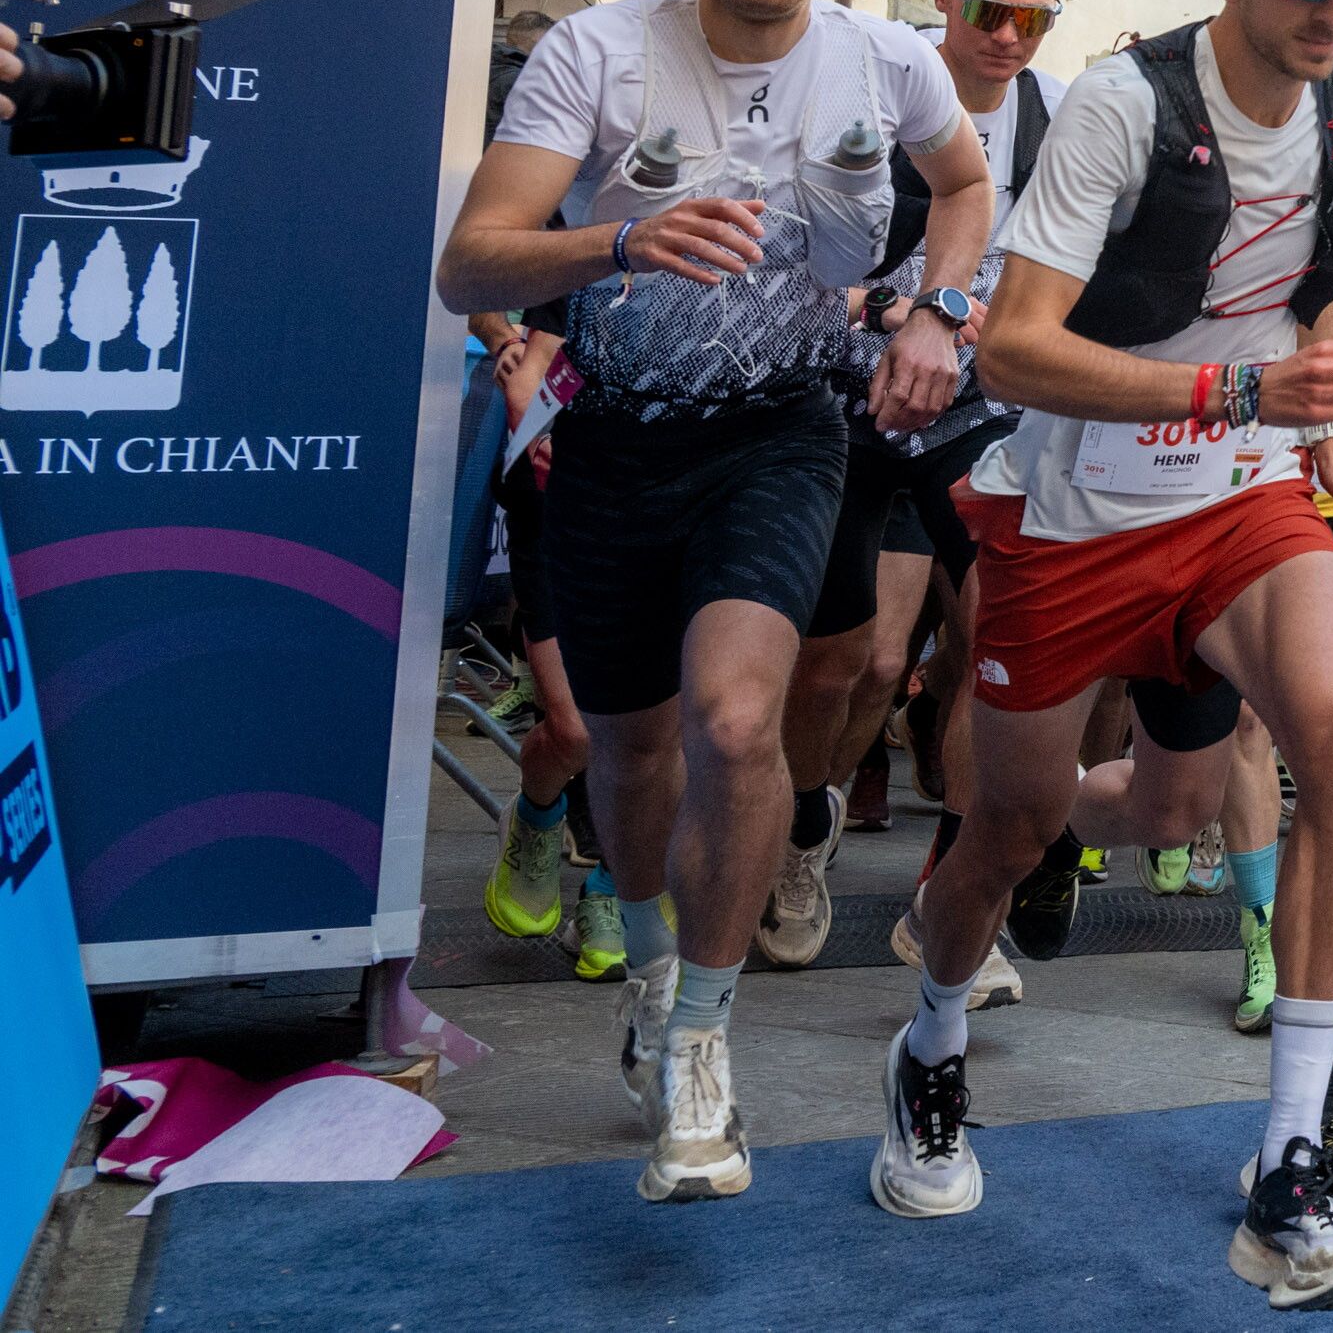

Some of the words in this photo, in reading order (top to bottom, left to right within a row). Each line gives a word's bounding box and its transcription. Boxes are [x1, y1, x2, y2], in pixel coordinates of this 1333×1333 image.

[36, 439, 101, 474] IN
[115, 435, 361, 472] CHIANTI
[1154, 453, 1200, 466] HENRI
